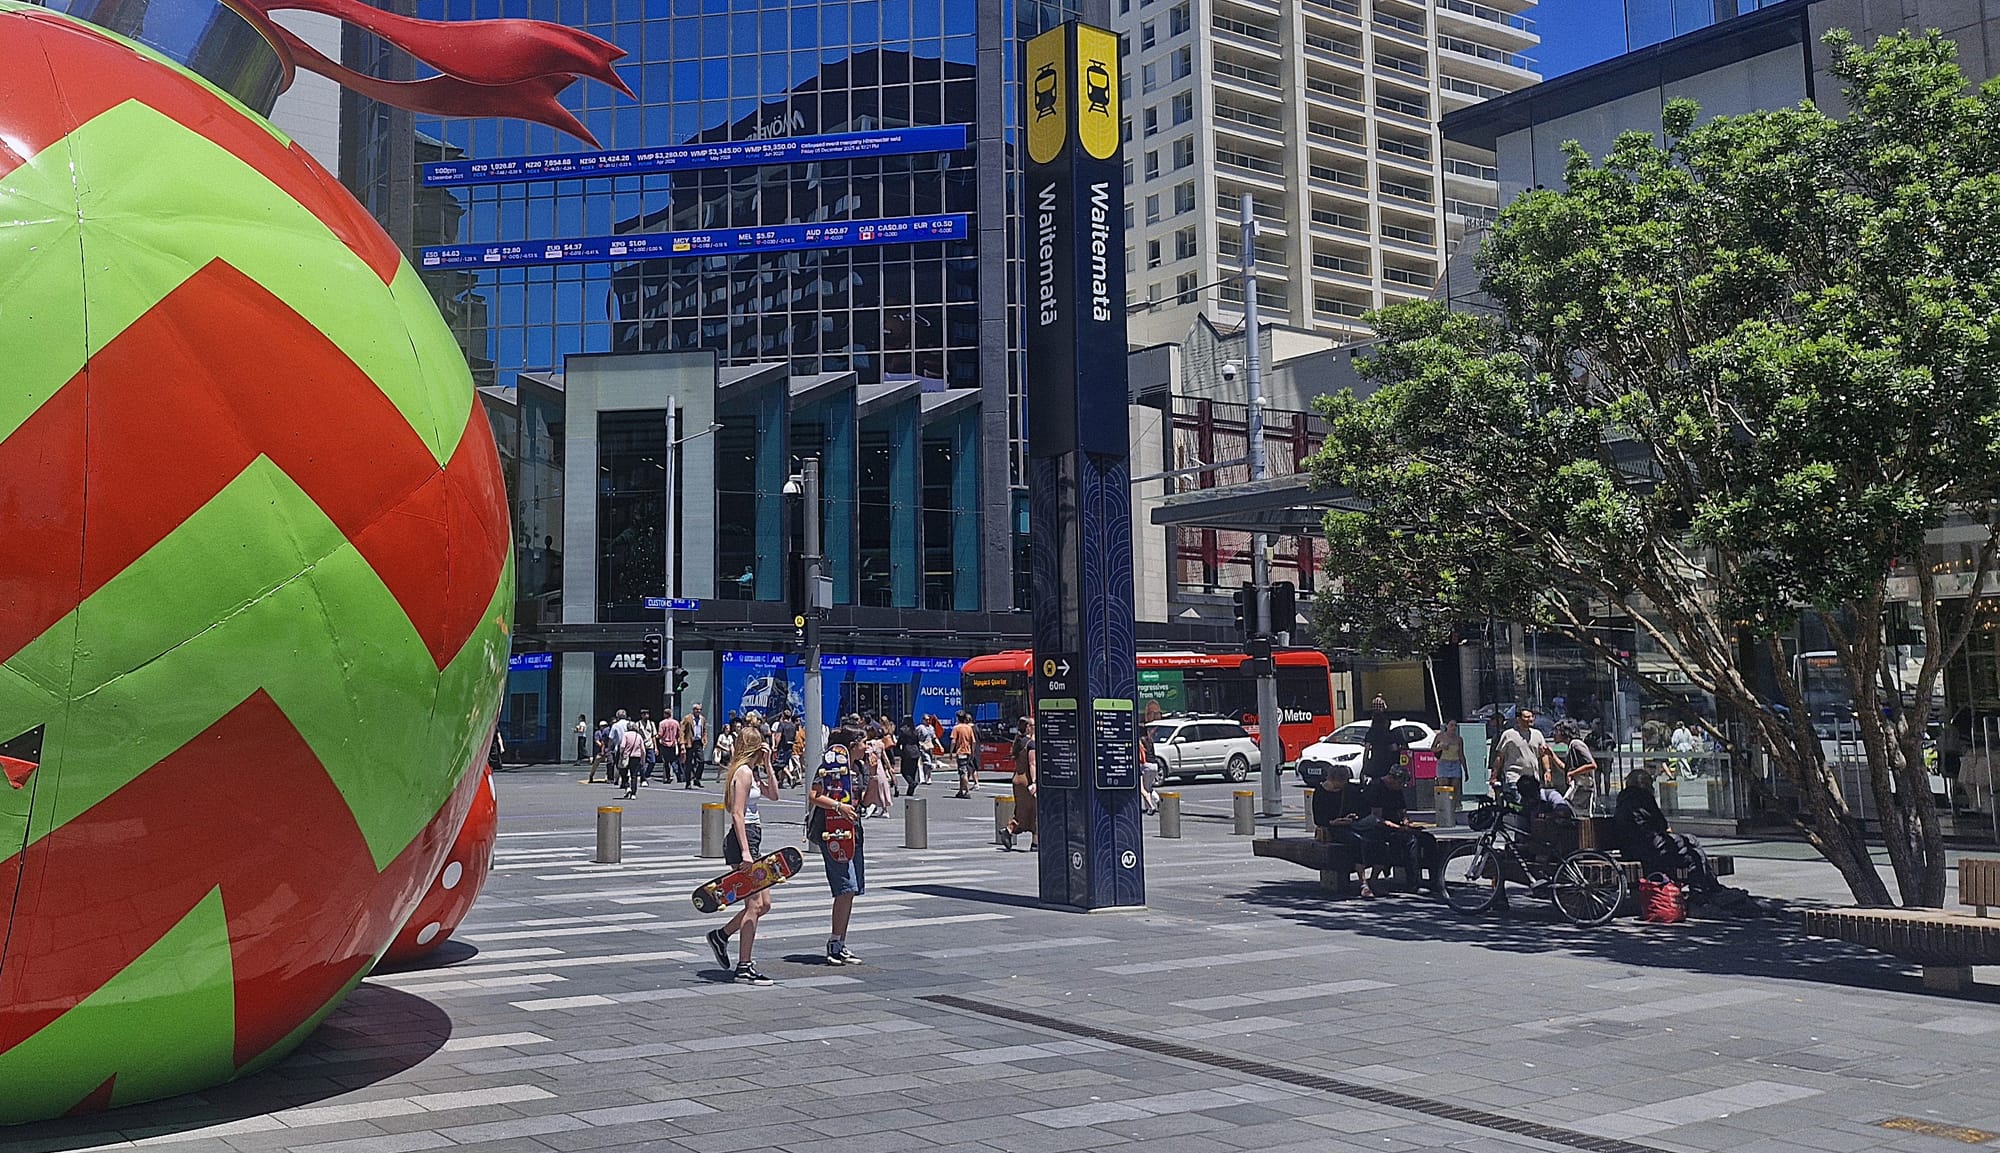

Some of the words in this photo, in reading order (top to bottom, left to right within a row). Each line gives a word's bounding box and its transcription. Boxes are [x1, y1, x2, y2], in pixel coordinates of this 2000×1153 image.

[690, 150, 708, 158] WMP
[471, 164, 488, 172] NZ10
[1036, 182, 1058, 326] Waitematā
[1090, 181, 1111, 323] Waitematā
[610, 653, 647, 669] ANZ
[920, 687, 960, 696] AUCKLAN
[1049, 681, 1066, 691] 60m
[1137, 683, 1168, 692] rogressives
[768, 696, 777, 708] FC
[1243, 713, 1260, 724] City
[1284, 709, 1312, 722] Metro
